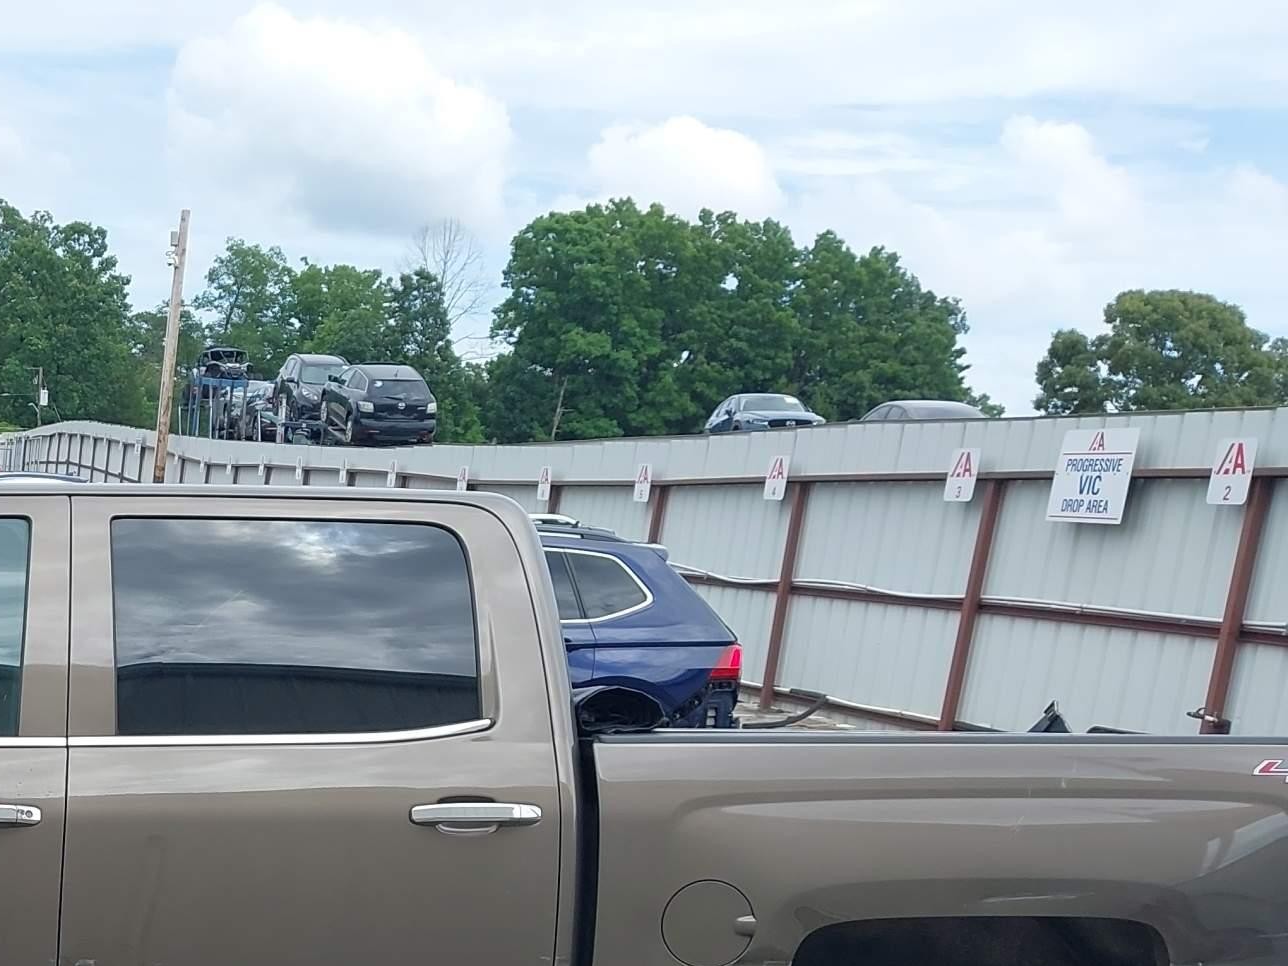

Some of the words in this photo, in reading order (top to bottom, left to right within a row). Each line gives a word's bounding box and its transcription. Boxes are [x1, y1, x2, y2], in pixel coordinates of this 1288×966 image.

[1065, 457, 1124, 473] PROGRESSIVE
[954, 485, 962, 499] 3
[1078, 474, 1102, 496] VIC
[1222, 485, 1232, 501] 2
[1060, 498, 1085, 513] DROP
[1085, 499, 1109, 514] AREA
